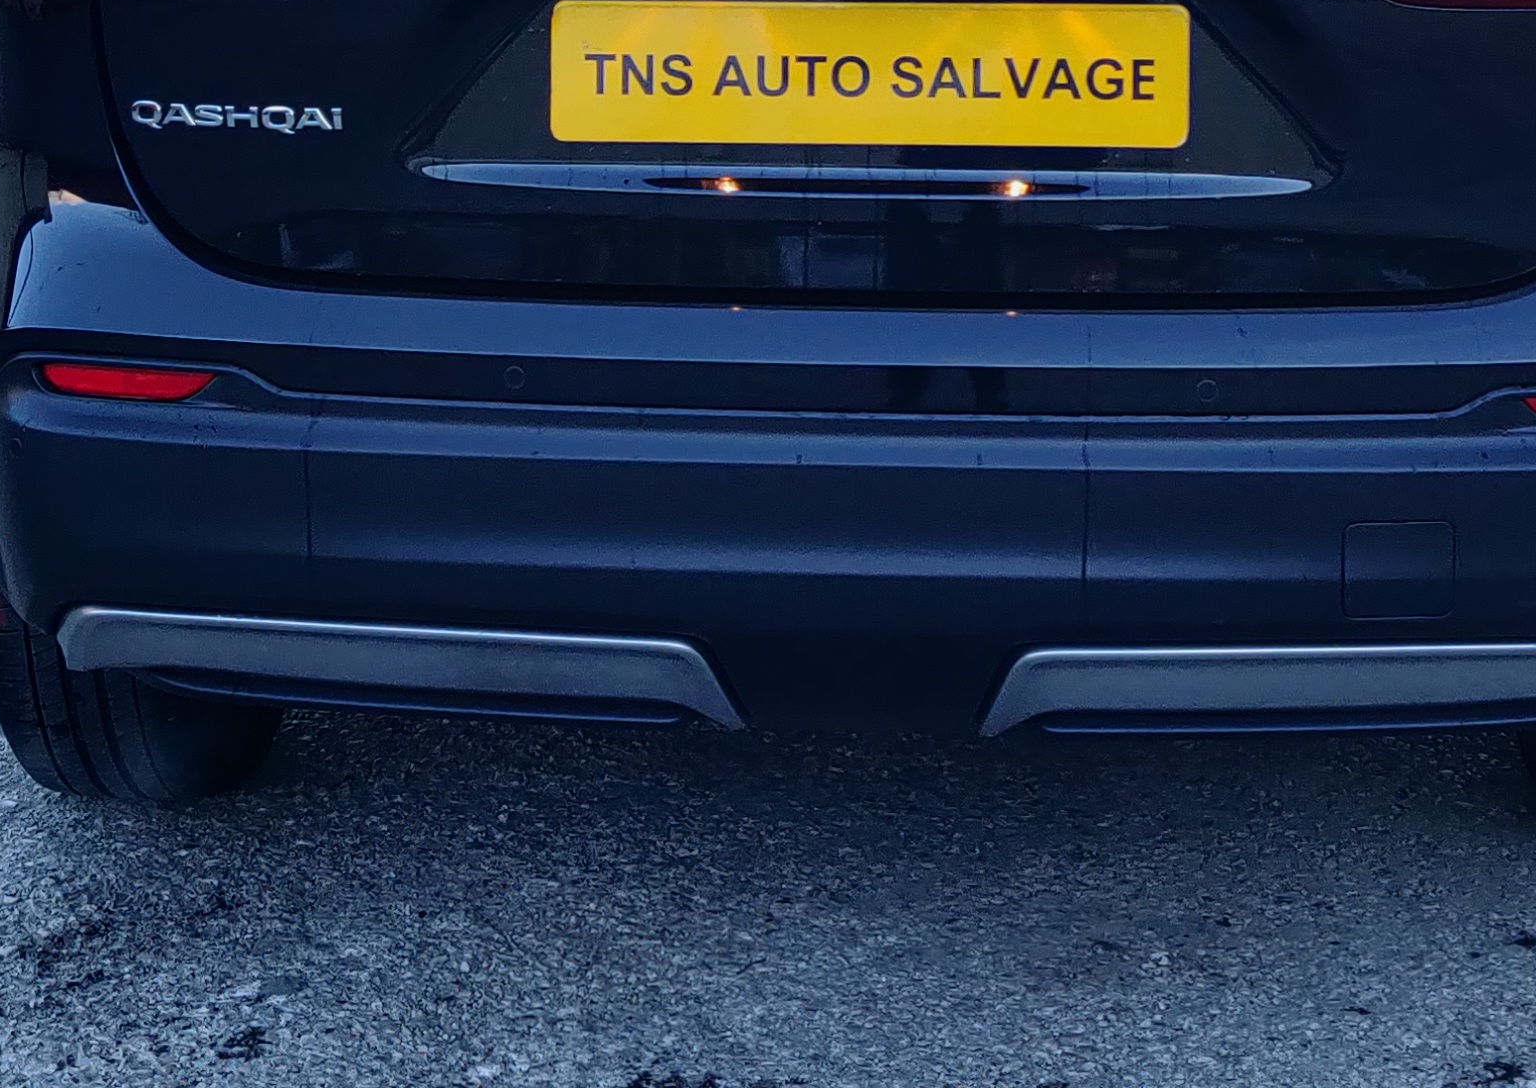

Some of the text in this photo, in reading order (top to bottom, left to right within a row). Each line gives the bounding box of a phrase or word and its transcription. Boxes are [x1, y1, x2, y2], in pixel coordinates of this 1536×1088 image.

[584, 52, 1156, 101] TNS AUTO SALVAGE
[131, 99, 343, 135] QASHQAI
